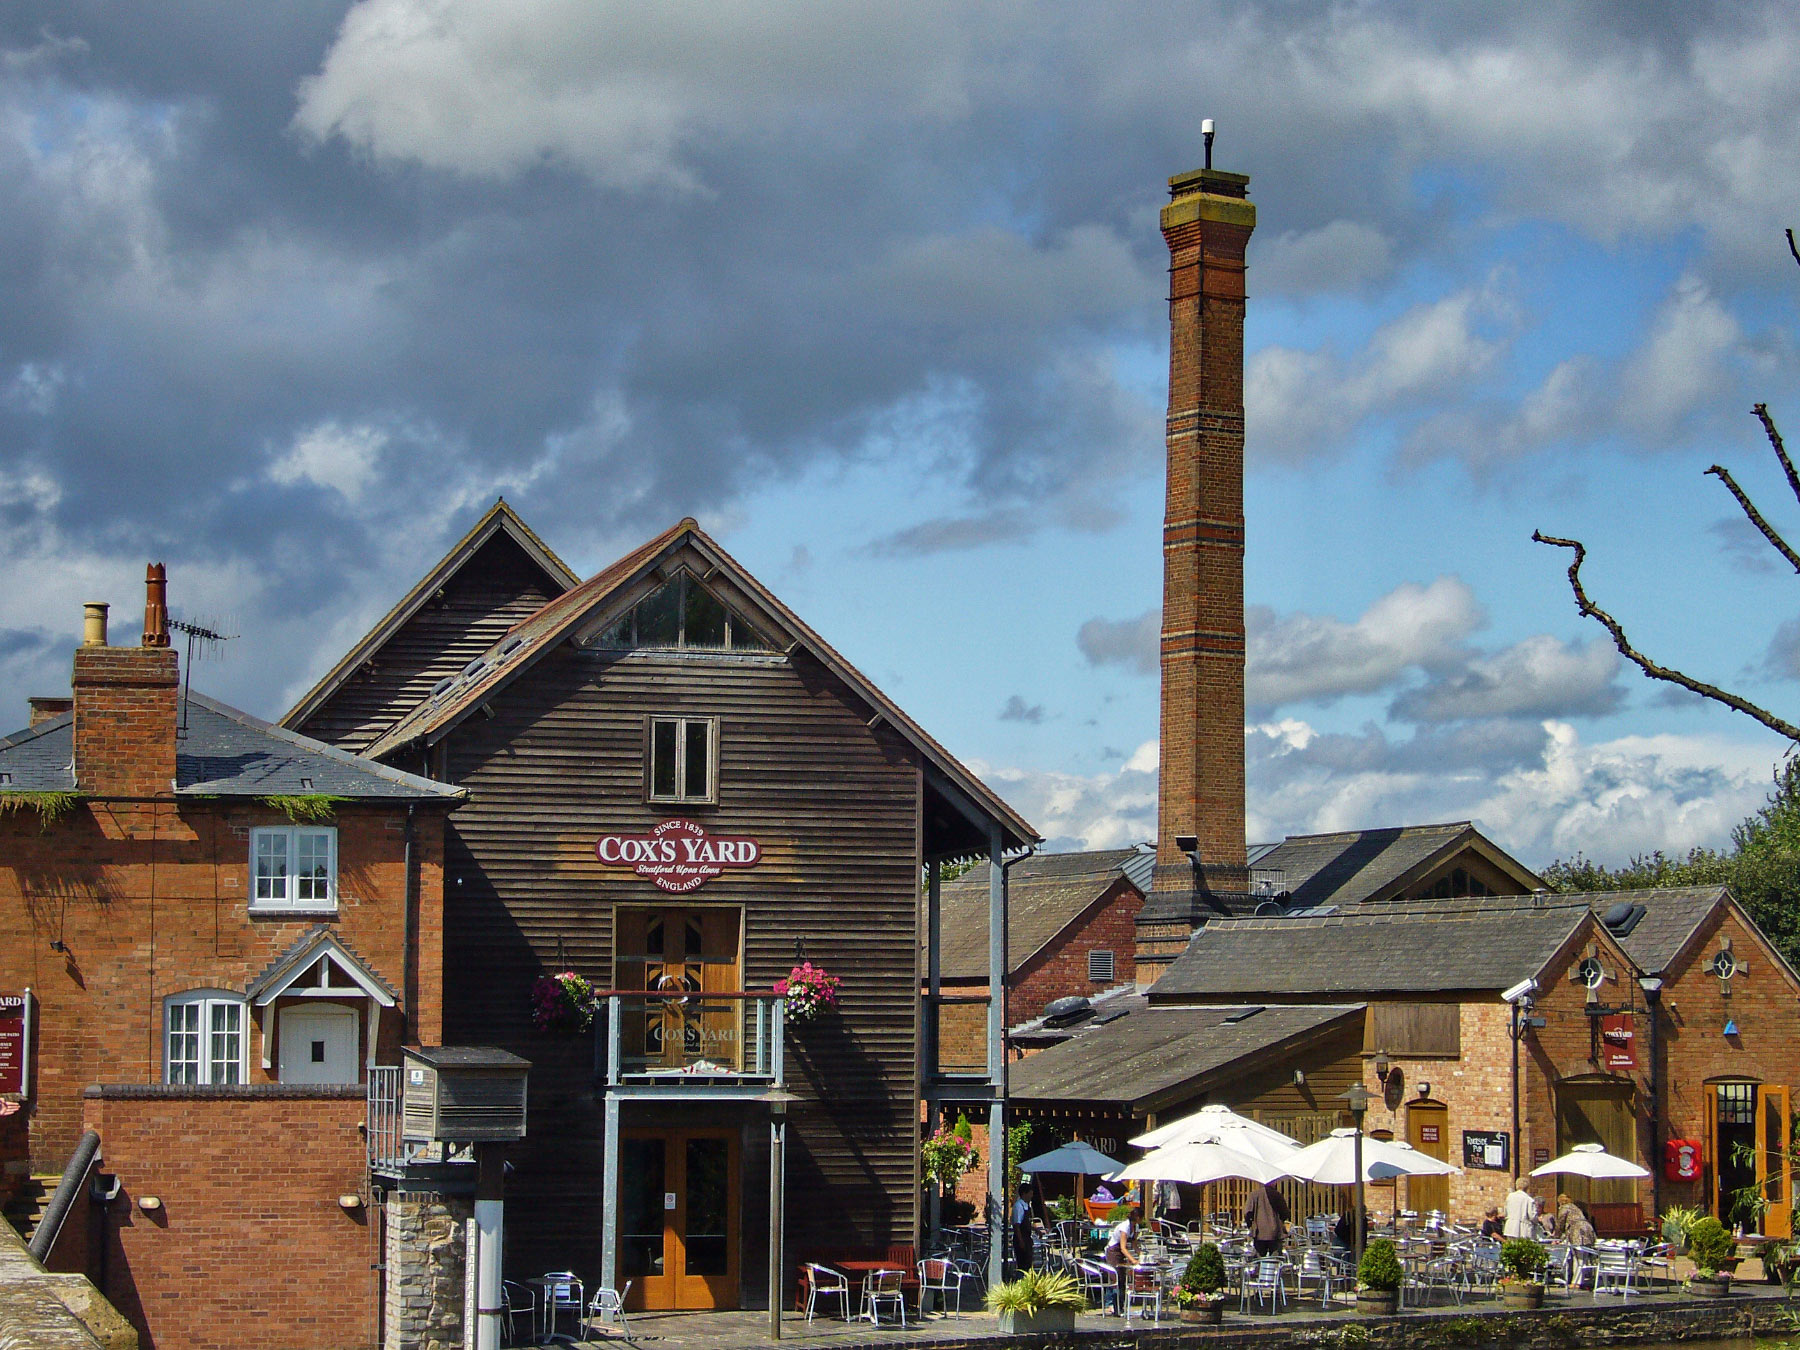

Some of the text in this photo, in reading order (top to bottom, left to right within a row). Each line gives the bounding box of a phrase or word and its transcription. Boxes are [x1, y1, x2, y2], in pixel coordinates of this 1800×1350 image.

[653, 820, 704, 836] SINCE 1839
[599, 836, 757, 863] COX'S YARD
[635, 864, 720, 876] Stratford Upon Avon
[656, 876, 702, 891] ENGLAND
[1084, 1135, 1117, 1154] YARD
